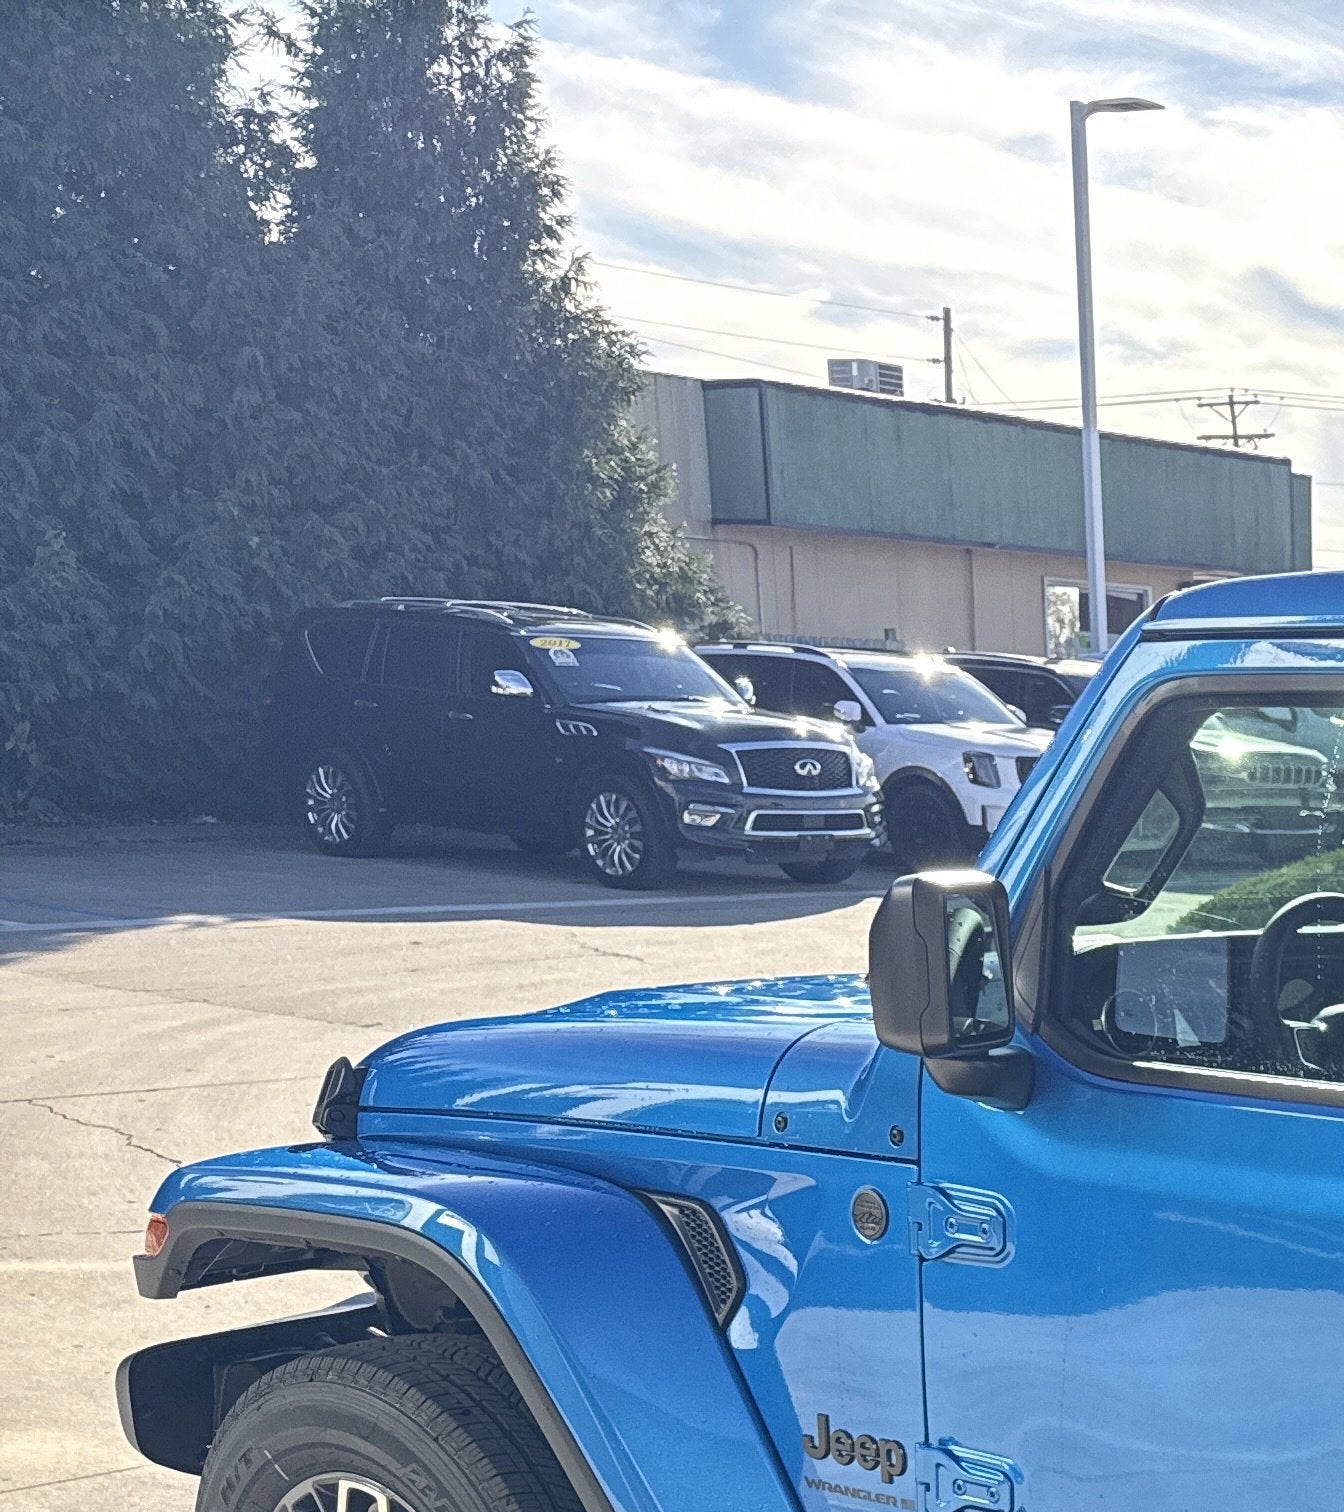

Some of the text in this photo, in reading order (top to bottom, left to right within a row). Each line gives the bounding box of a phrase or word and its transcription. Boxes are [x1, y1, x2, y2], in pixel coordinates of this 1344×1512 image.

[540, 639, 571, 648] 2017
[802, 1413, 908, 1485] Jeep
[804, 1476, 898, 1507] WRANGLER
